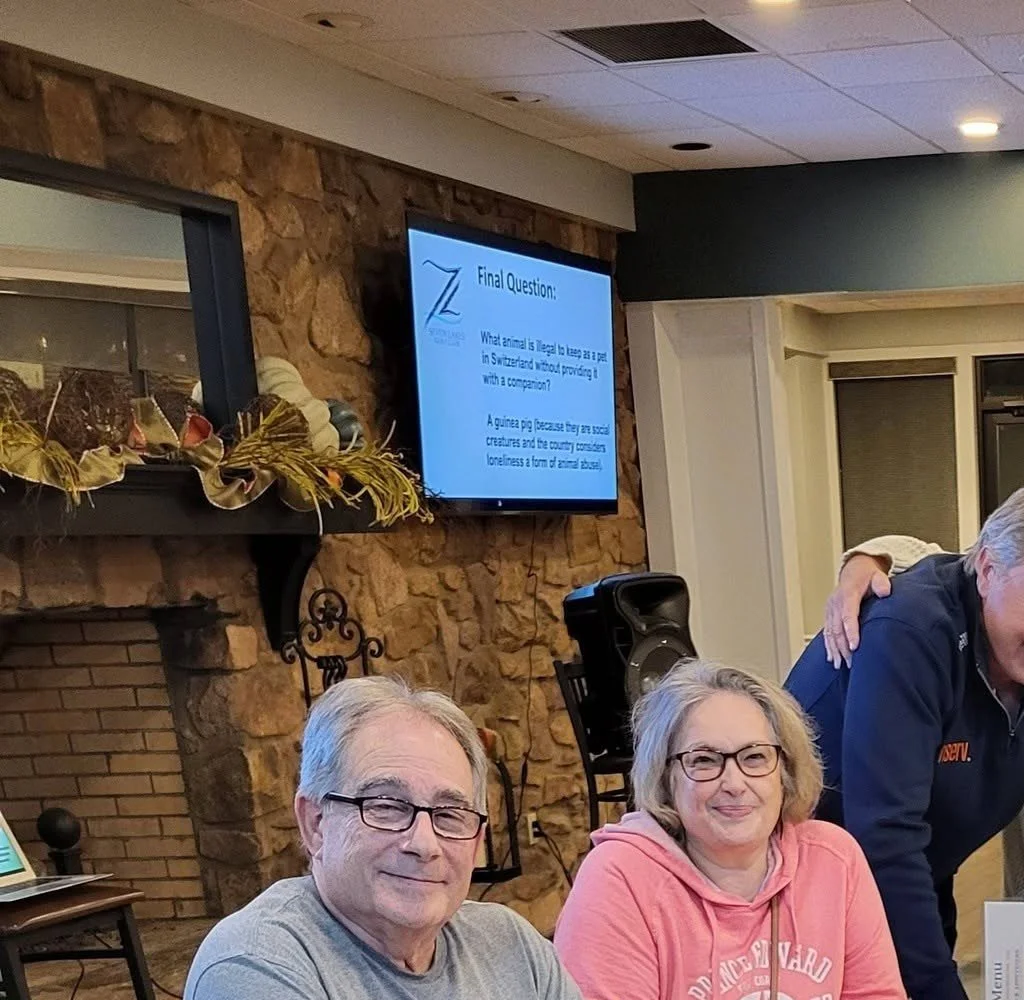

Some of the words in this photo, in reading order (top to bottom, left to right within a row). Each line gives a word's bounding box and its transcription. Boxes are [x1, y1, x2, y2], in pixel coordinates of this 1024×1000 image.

[477, 265, 504, 289] Final
[506, 271, 557, 300] Question:
[480, 330, 501, 346] What
[502, 336, 527, 350] animal
[528, 338, 535, 351] is
[536, 339, 556, 357] illegal
[557, 344, 565, 355] to
[566, 345, 582, 359] keep
[582, 349, 591, 360] as
[591, 350, 597, 361] a
[597, 351, 608, 363] pet
[482, 350, 490, 365] in
[491, 352, 534, 370] Switzerland
[535, 359, 561, 373] without
[562, 364, 592, 381] providing
[593, 366, 598, 379] it
[483, 371, 500, 385] with
[500, 376, 506, 387] a
[507, 377, 551, 392] companion?
[487, 413, 494, 427] A
[494, 416, 520, 430] guinea
[521, 417, 533, 433] pig
[534, 418, 565, 433] (because
[565, 421, 580, 437] they
[580, 424, 591, 435] are
[592, 423, 610, 436] social
[486, 436, 521, 448] creatures
[522, 437, 536, 449] and
[537, 437, 549, 450] the
[549, 440, 575, 454] country
[575, 441, 606, 453] considers
[486, 453, 525, 467] loneliness
[525, 457, 531, 468] a
[531, 455, 549, 468] form
[549, 456, 557, 468] of
[557, 457, 580, 470] animal
